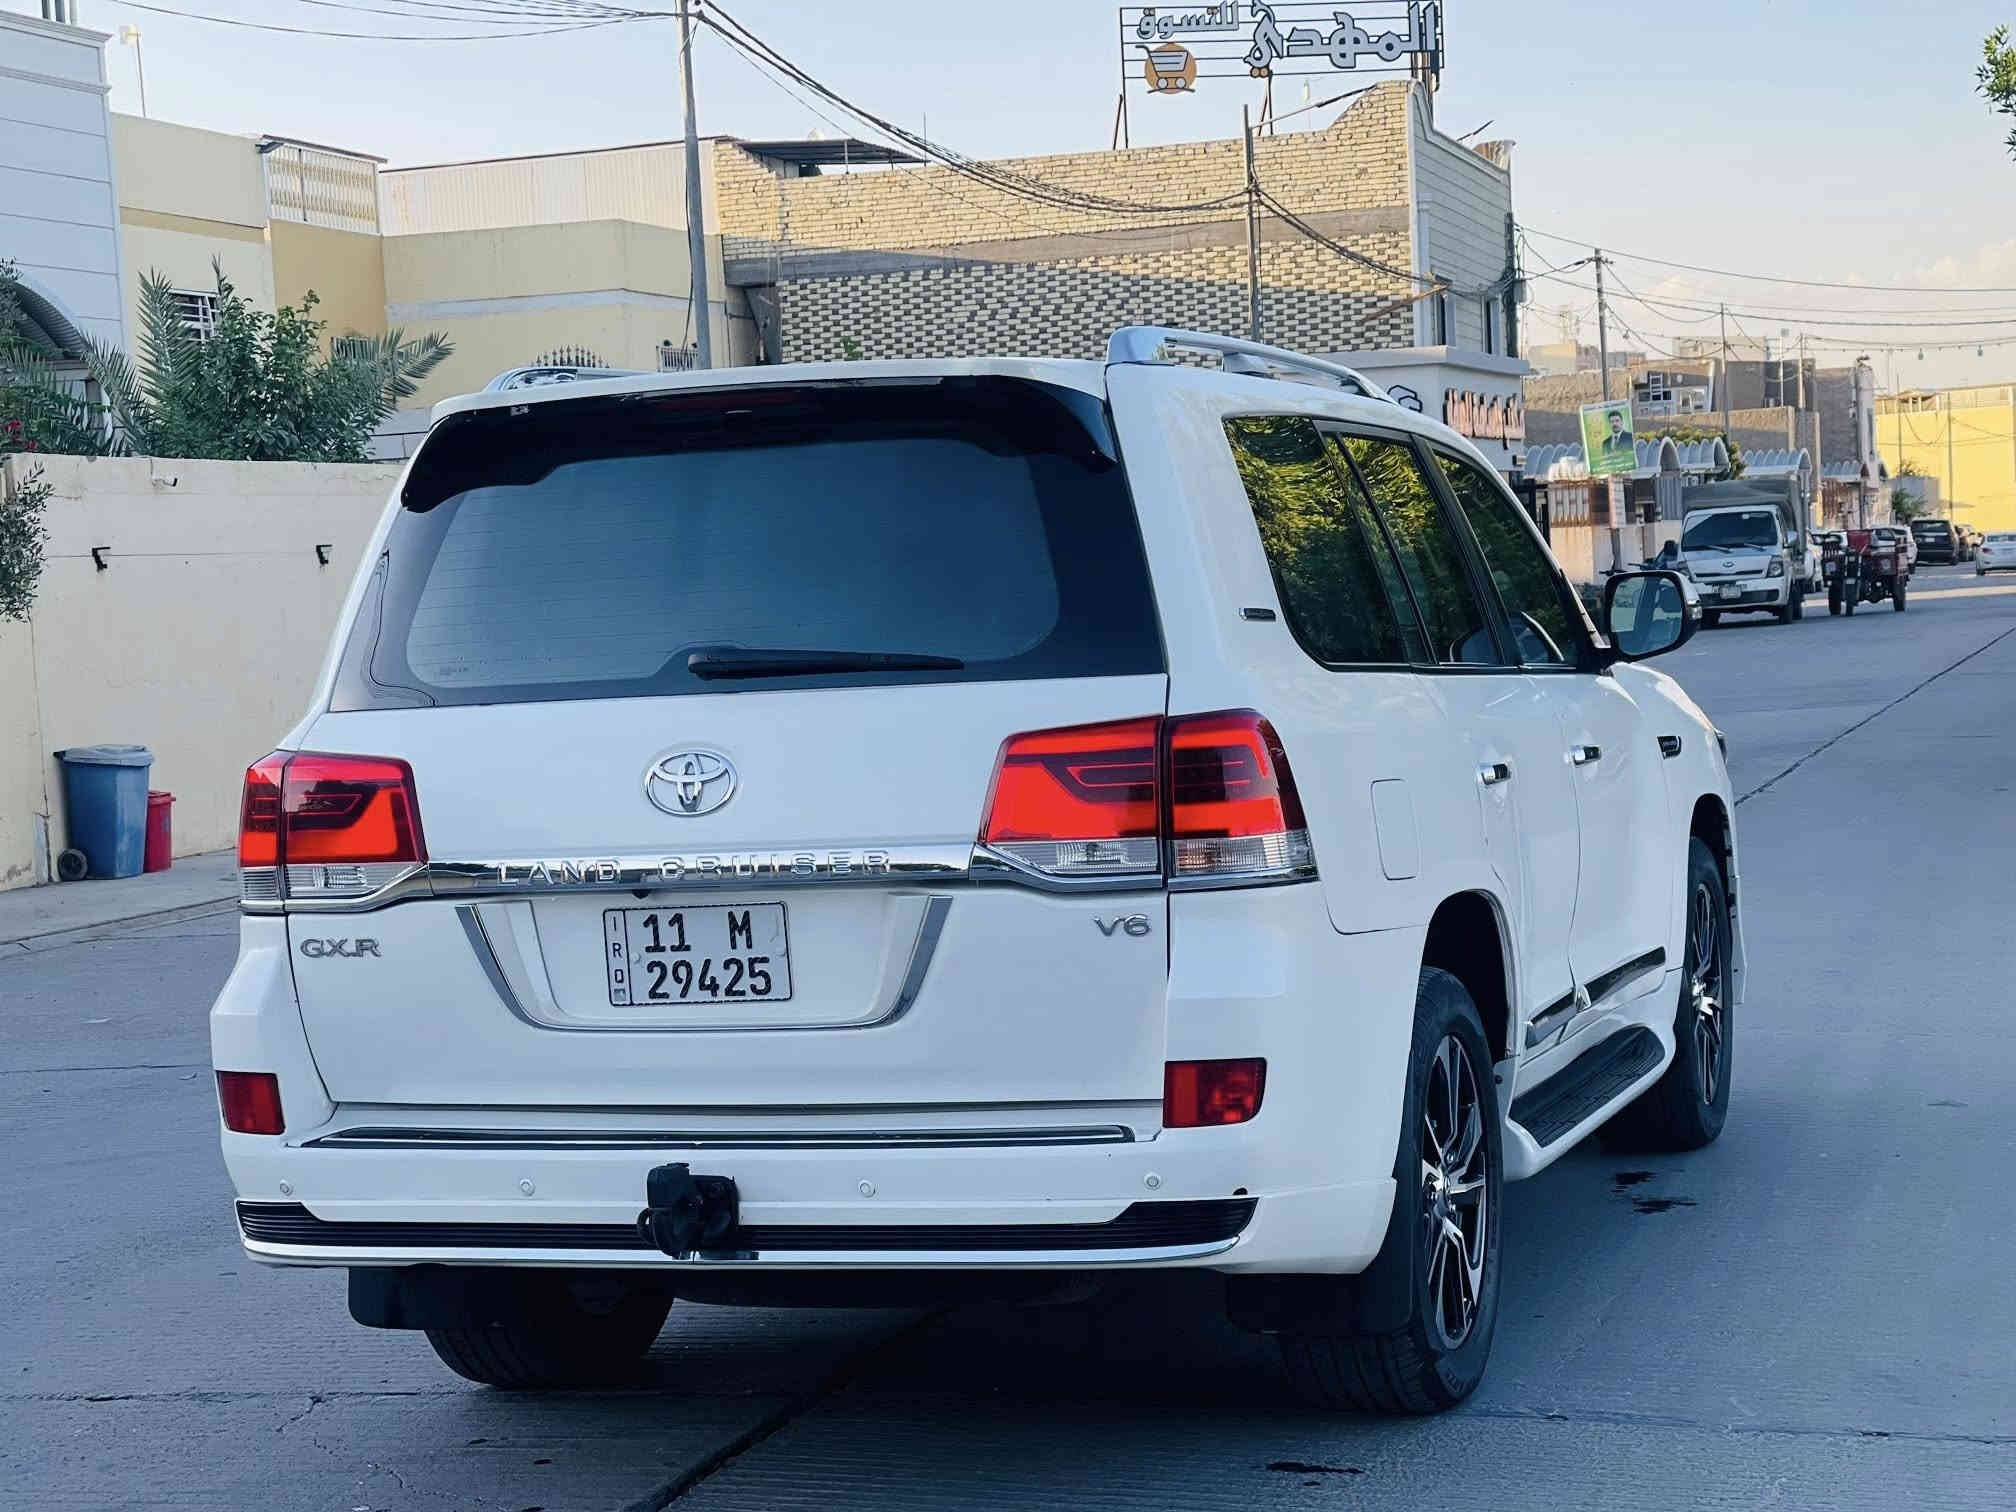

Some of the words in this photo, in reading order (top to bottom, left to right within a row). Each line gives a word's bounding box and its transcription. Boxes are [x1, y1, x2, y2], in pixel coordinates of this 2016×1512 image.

[1136, 0, 1240, 40] للتسوق
[495, 859, 621, 886] LAND
[658, 848, 891, 881] CRUISER
[643, 913, 692, 953] 11
[727, 910, 753, 950] M
[1092, 913, 1152, 937] V6
[300, 938, 382, 959] GXR
[646, 956, 772, 999] 29425
